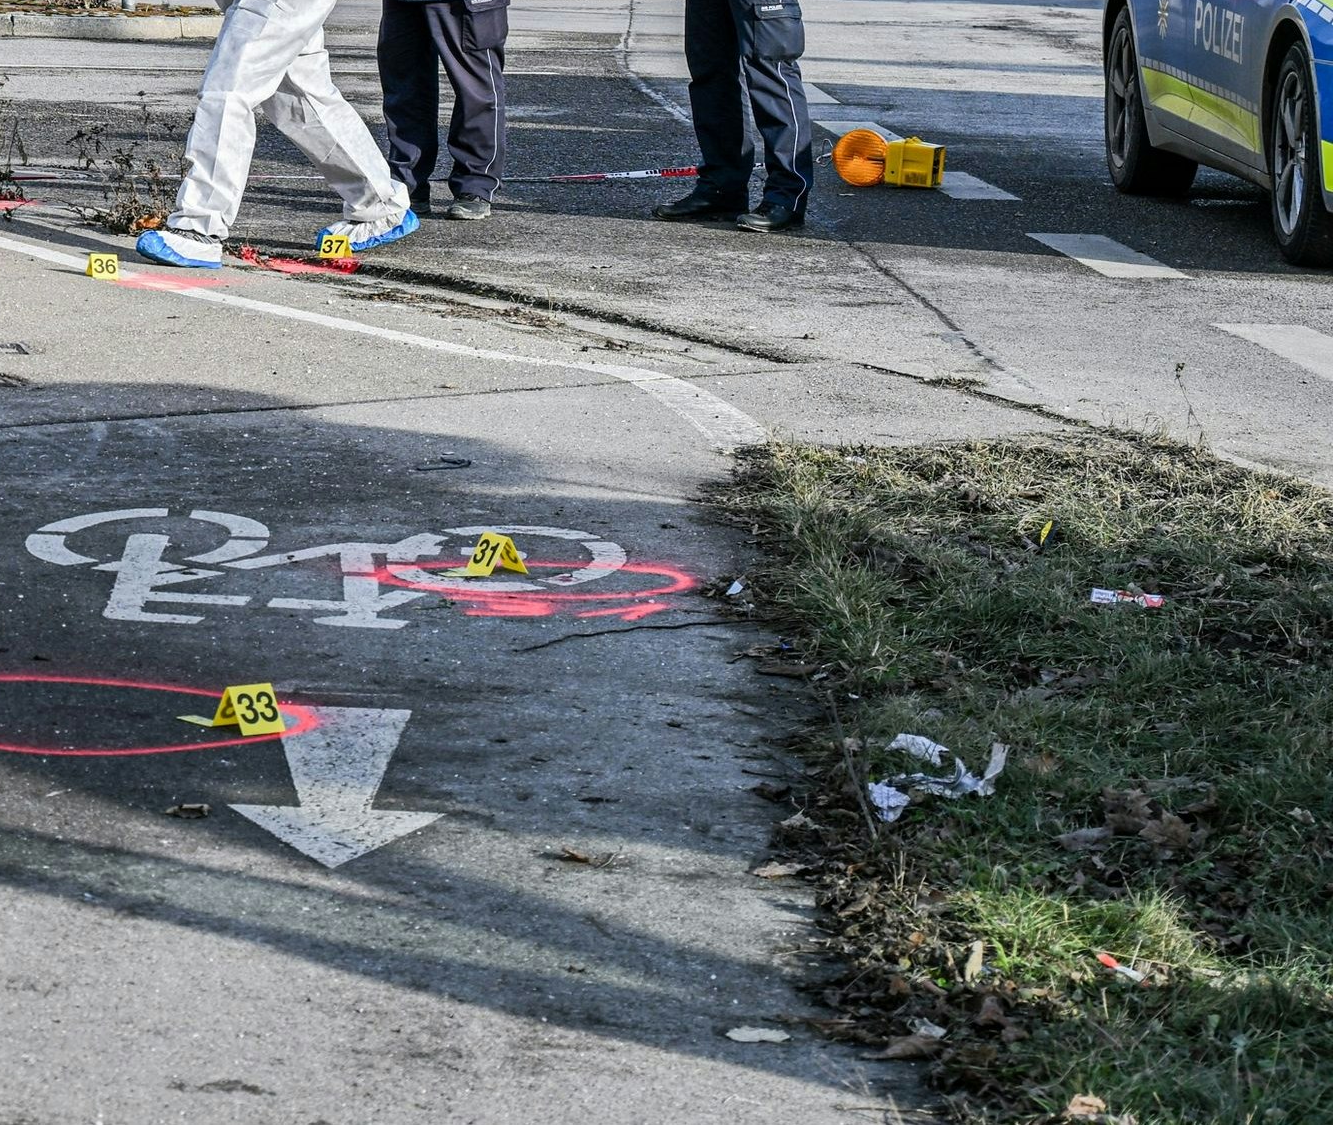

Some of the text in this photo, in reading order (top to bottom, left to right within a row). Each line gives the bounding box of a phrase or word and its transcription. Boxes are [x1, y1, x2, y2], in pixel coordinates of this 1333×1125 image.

[322, 239, 345, 254] 37
[93, 258, 116, 274] 36
[473, 538, 500, 567] 31
[237, 691, 279, 725] 33
